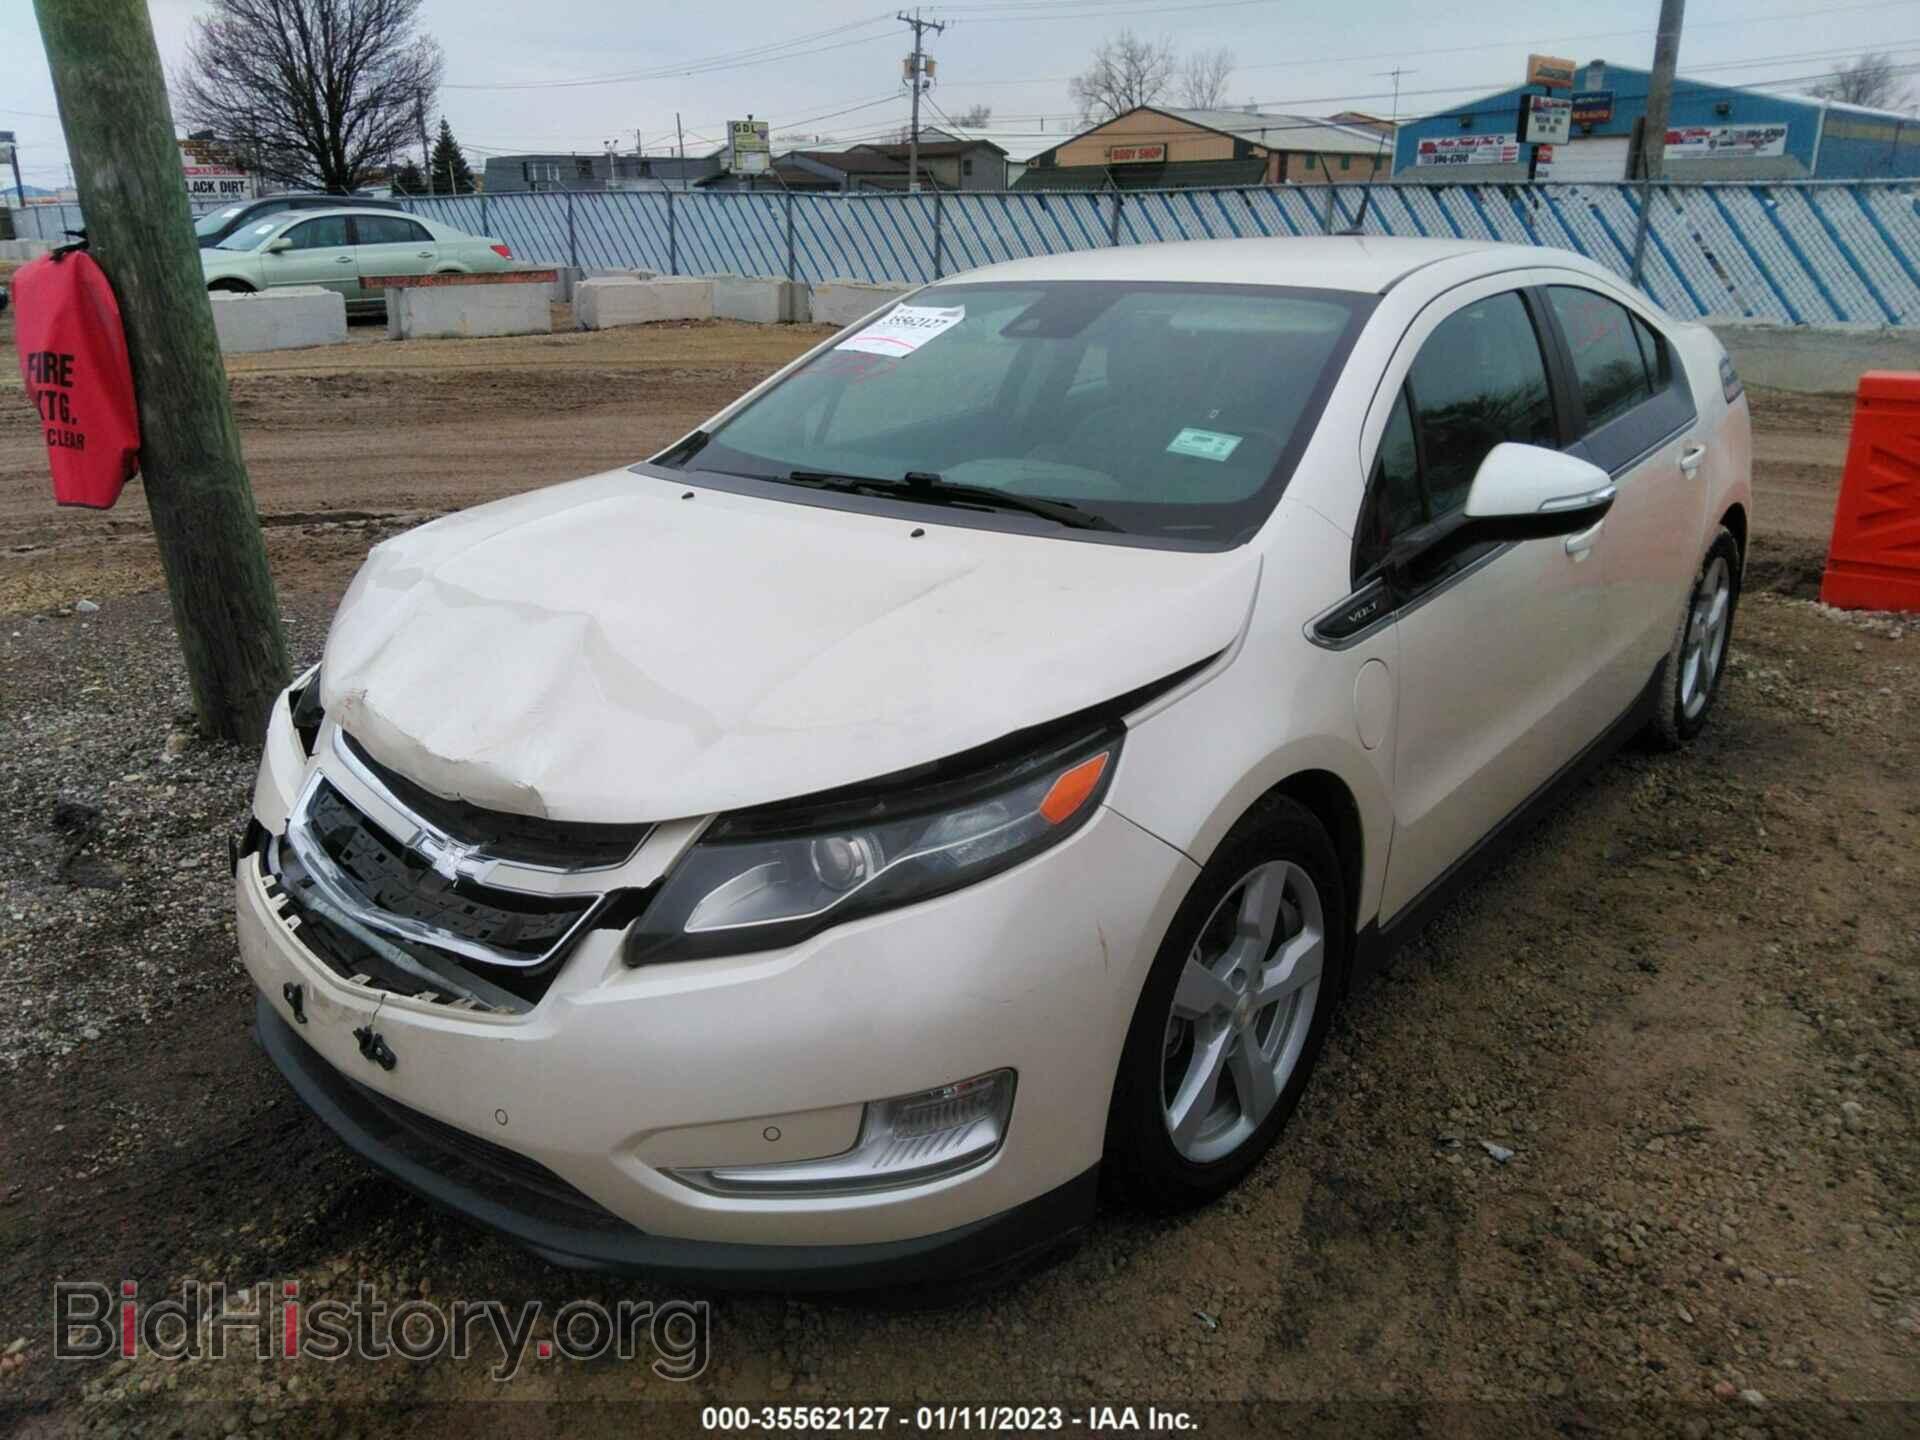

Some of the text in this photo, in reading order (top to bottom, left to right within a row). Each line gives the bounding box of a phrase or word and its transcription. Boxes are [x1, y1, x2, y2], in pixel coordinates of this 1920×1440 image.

[1112, 146, 1162, 160] BODY SHOP
[185, 181, 216, 193] LACK
[28, 352, 75, 387] FIRE
[47, 428, 85, 450] CLEAR
[1348, 602, 1377, 622] VOLT
